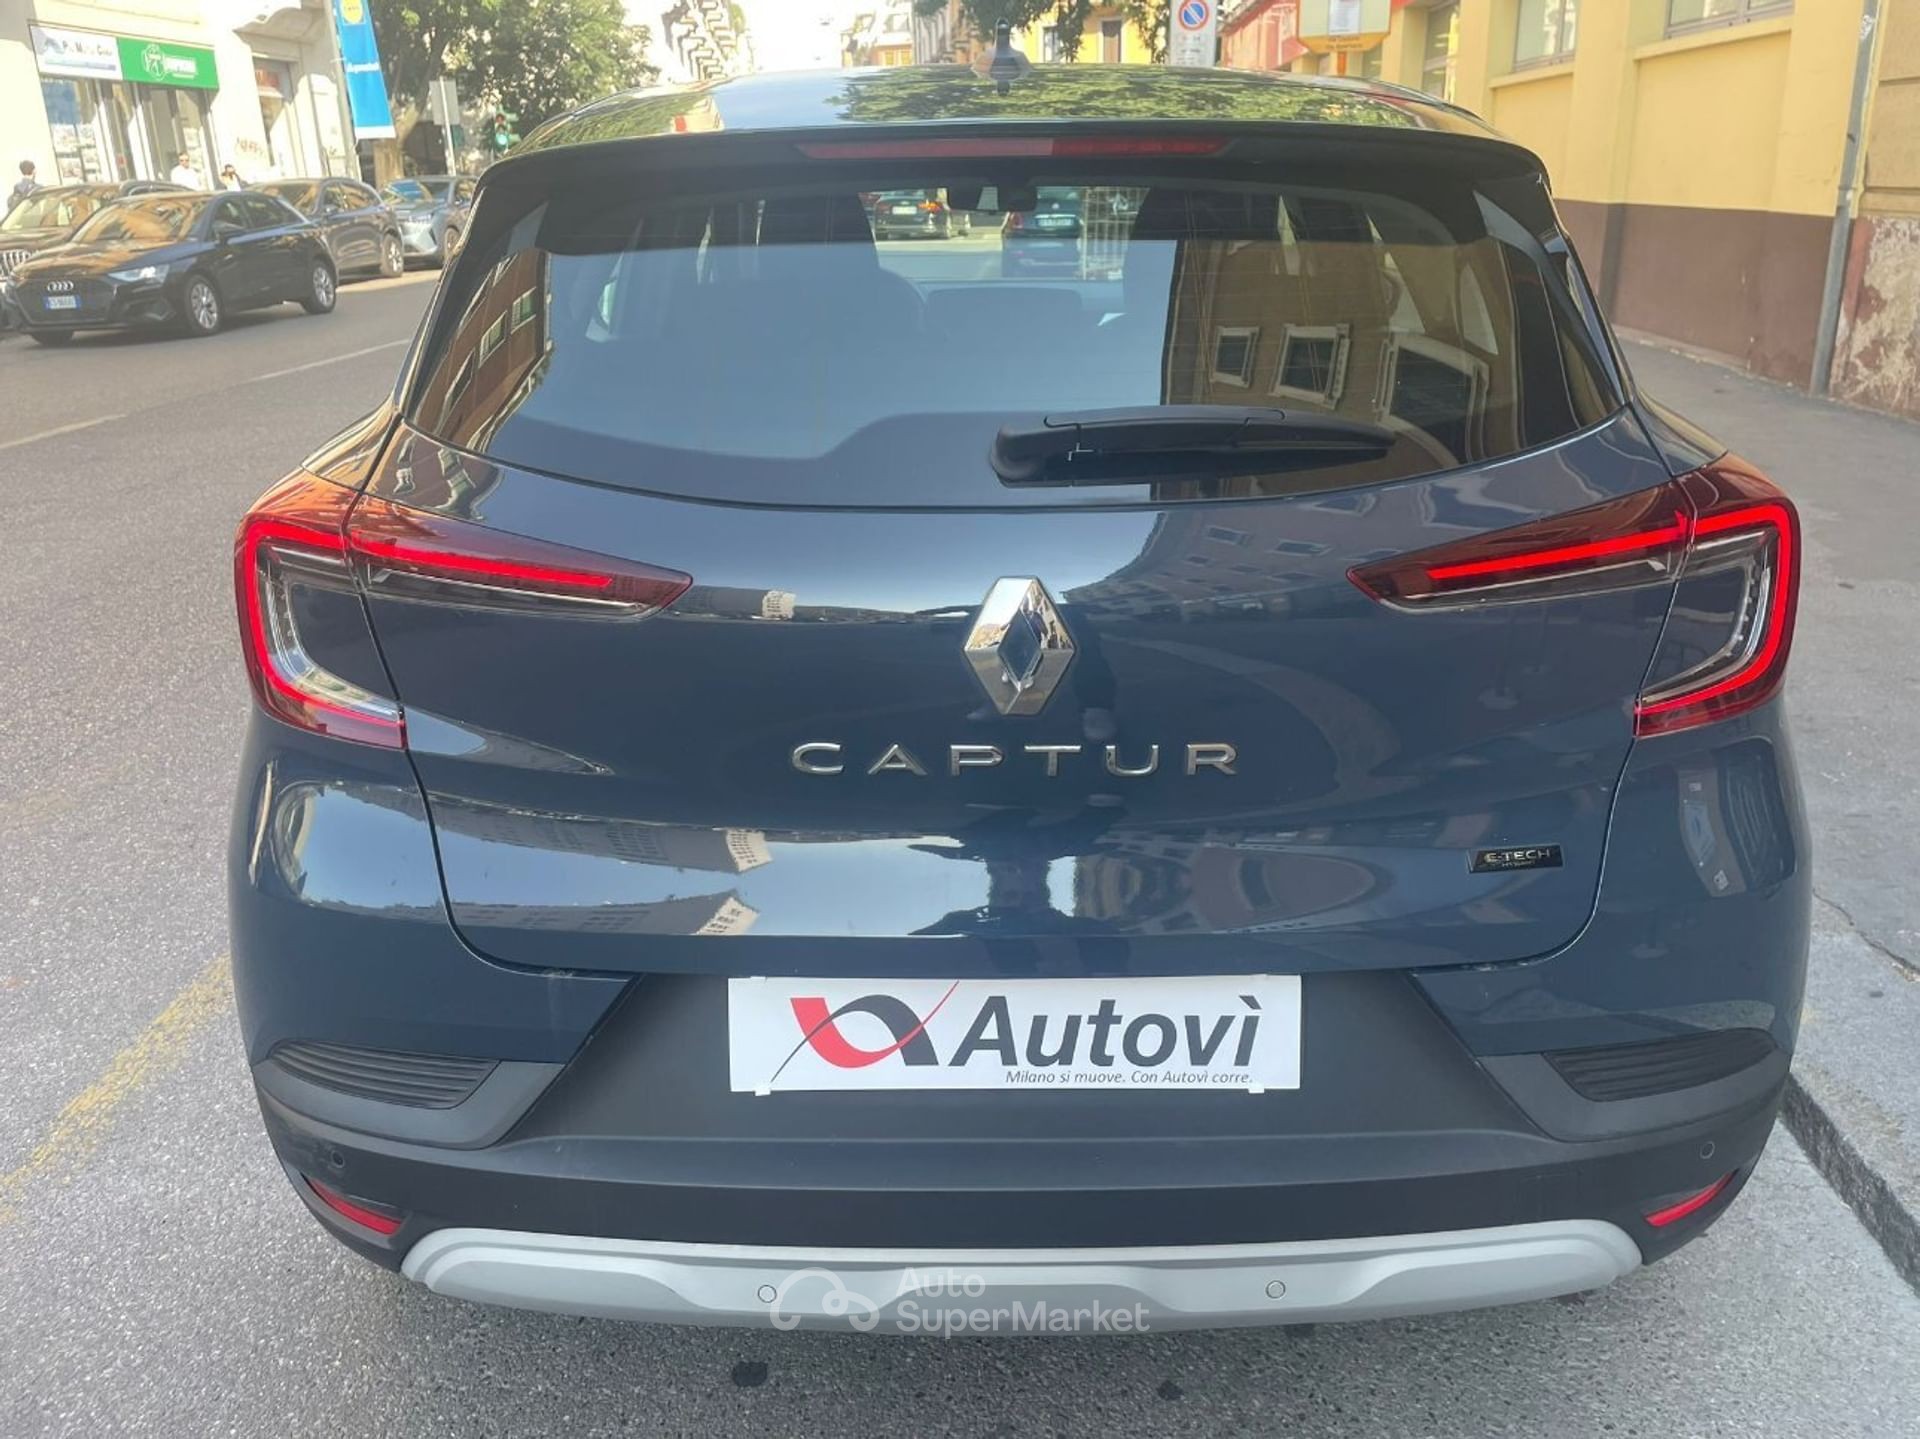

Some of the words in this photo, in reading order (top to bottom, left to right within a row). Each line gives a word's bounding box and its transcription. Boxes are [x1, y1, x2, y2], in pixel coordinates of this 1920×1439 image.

[791, 742, 1239, 777] CAPTUR
[948, 994, 1262, 1067] Autovì
[1005, 1070, 1055, 1083] Milano
[1060, 1070, 1071, 1083] si
[1074, 1072, 1126, 1083] muove.
[1131, 1070, 1158, 1083] Con
[1161, 1070, 1208, 1083] Autovì
[1211, 1073, 1253, 1083] corre.
